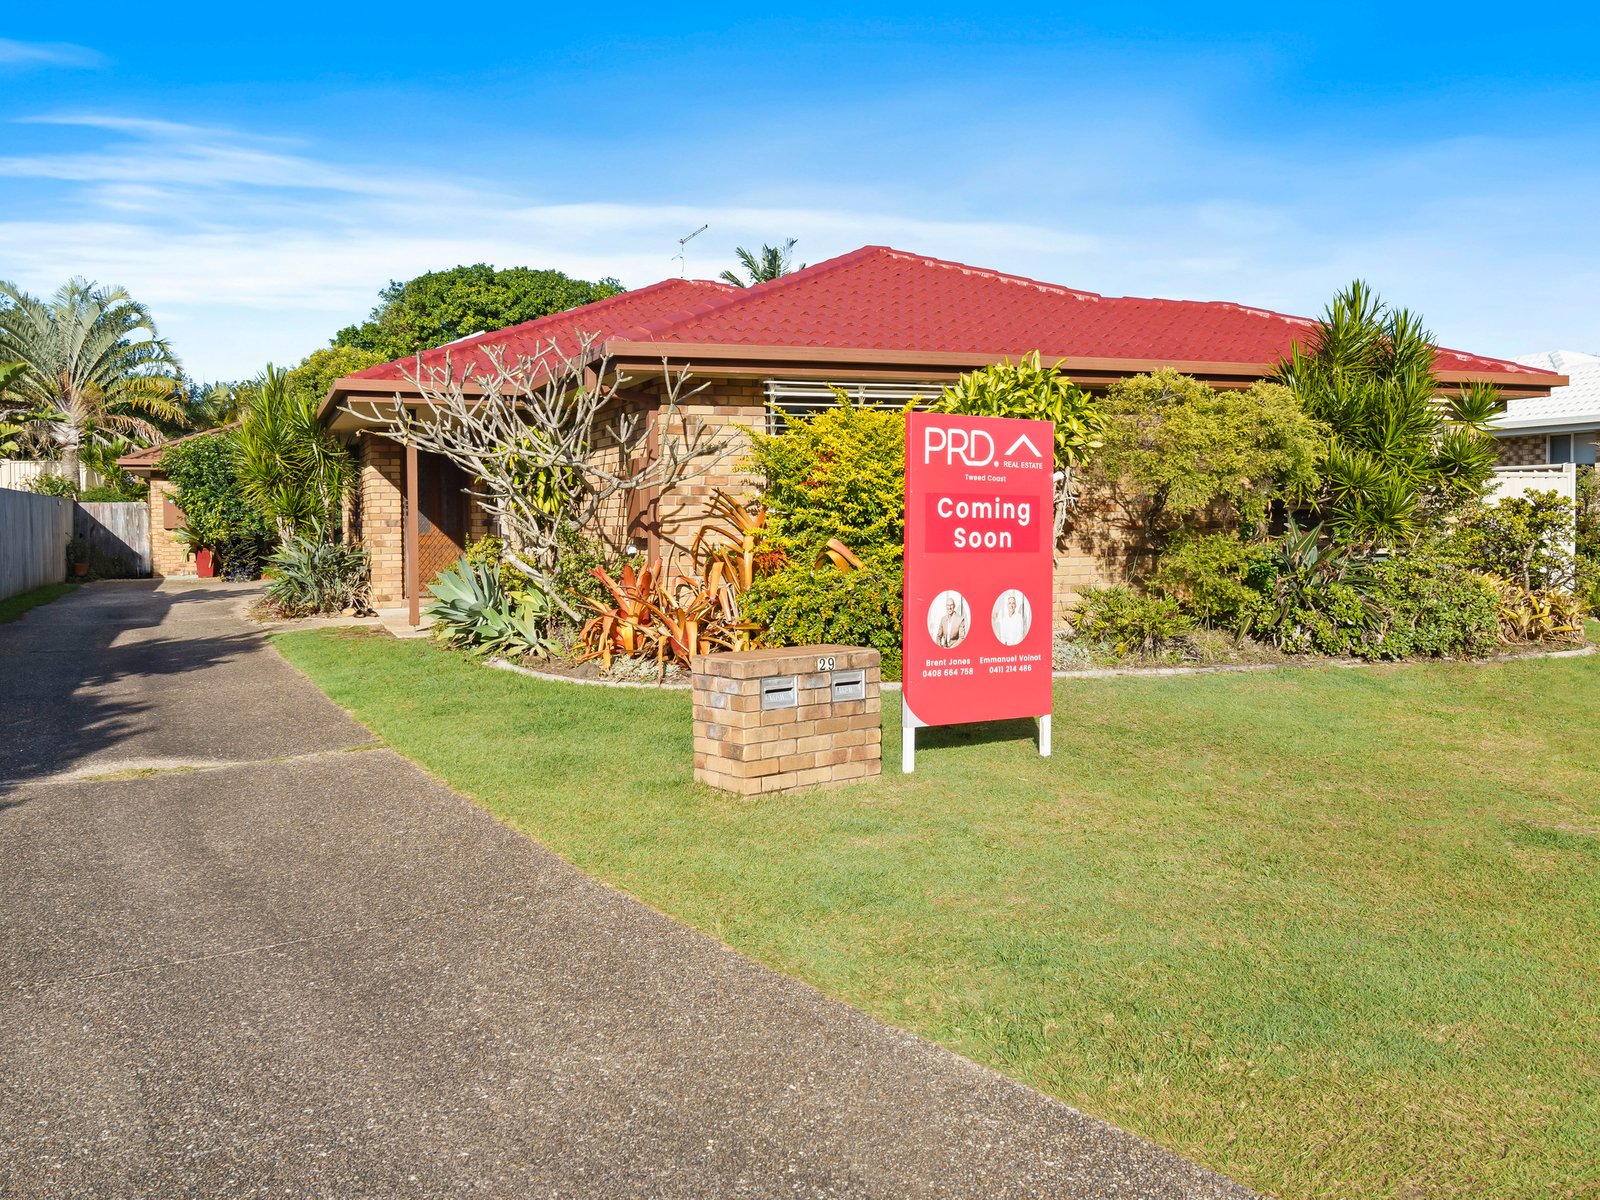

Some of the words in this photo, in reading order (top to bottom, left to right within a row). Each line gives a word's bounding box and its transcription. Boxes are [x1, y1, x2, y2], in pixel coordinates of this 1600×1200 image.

[1003, 461, 1020, 469] REAL
[1020, 462, 1043, 470] ESTATE
[937, 496, 1030, 526] Coming
[954, 526, 1012, 548] Soon
[819, 658, 835, 671] 29
[926, 659, 946, 667] Brent
[948, 658, 970, 666] Jones
[980, 655, 1017, 664] Emmanuel
[922, 669, 942, 678] 0408
[944, 668, 958, 676] 664
[989, 665, 1004, 674] 0411
[1005, 664, 1017, 673] 214
[1018, 664, 1032, 672] 486
